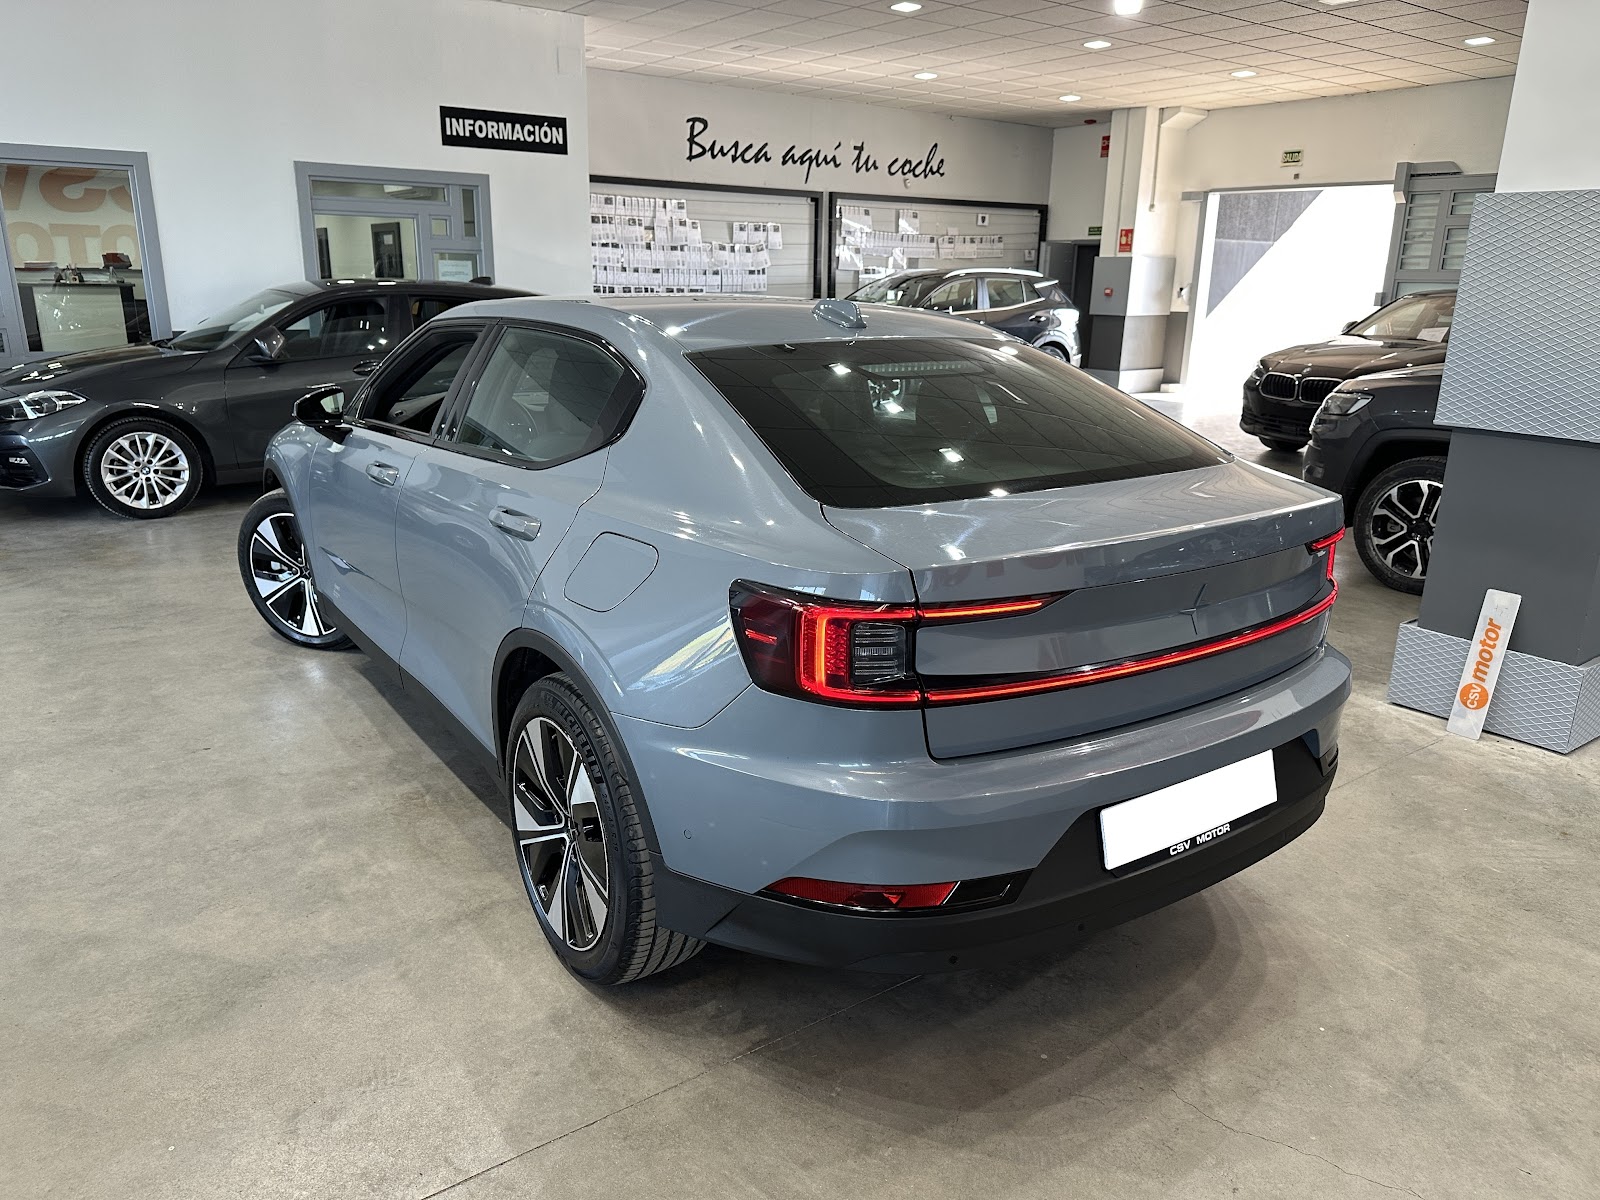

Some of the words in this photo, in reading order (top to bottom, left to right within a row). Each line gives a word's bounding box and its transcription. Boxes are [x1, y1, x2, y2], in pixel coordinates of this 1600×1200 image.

[445, 117, 563, 145] INFORMACIÓN
[686, 116, 771, 164] Busca
[781, 142, 841, 184] aquí
[852, 142, 878, 173] tu
[887, 143, 945, 179] coche
[1472, 617, 1502, 683] motor
[551, 699, 602, 778] MICHELIN
[1169, 840, 1191, 856] CSV
[1196, 823, 1231, 845] MOTOR
